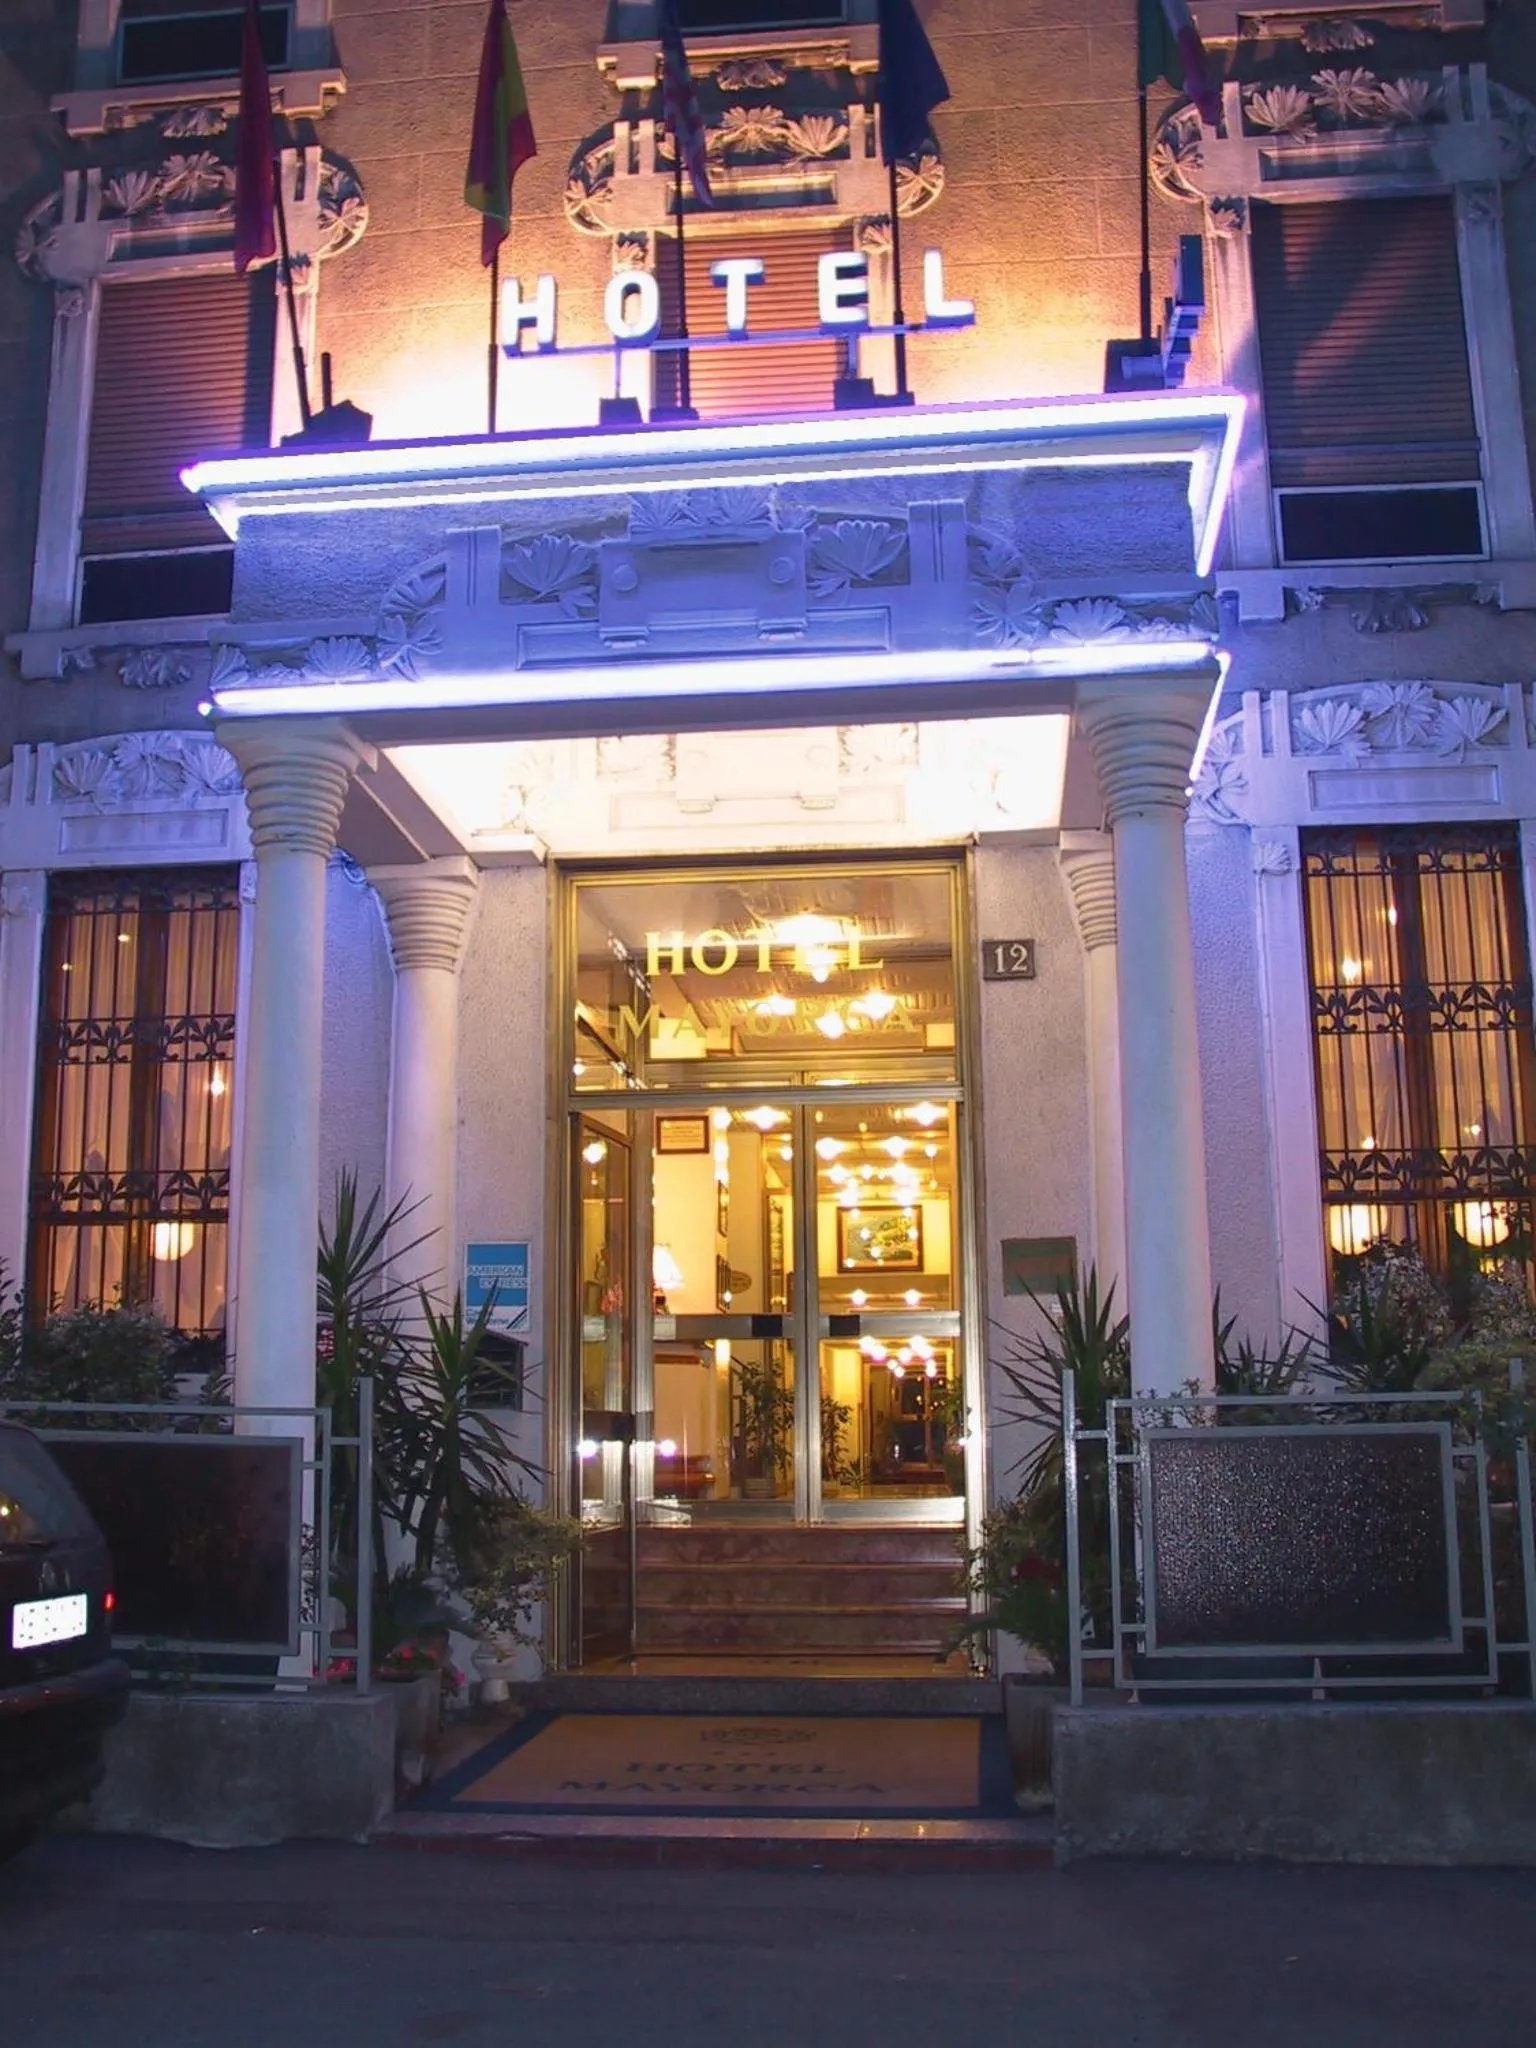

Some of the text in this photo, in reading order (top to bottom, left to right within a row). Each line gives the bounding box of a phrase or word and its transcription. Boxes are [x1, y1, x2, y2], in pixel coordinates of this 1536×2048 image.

[500, 247, 976, 356] HOTEL
[644, 921, 884, 976] HOTEL
[994, 943, 1028, 973] 12
[624, 1761, 848, 1774] HOTEL
[558, 1780, 887, 1794] MAYORCA
